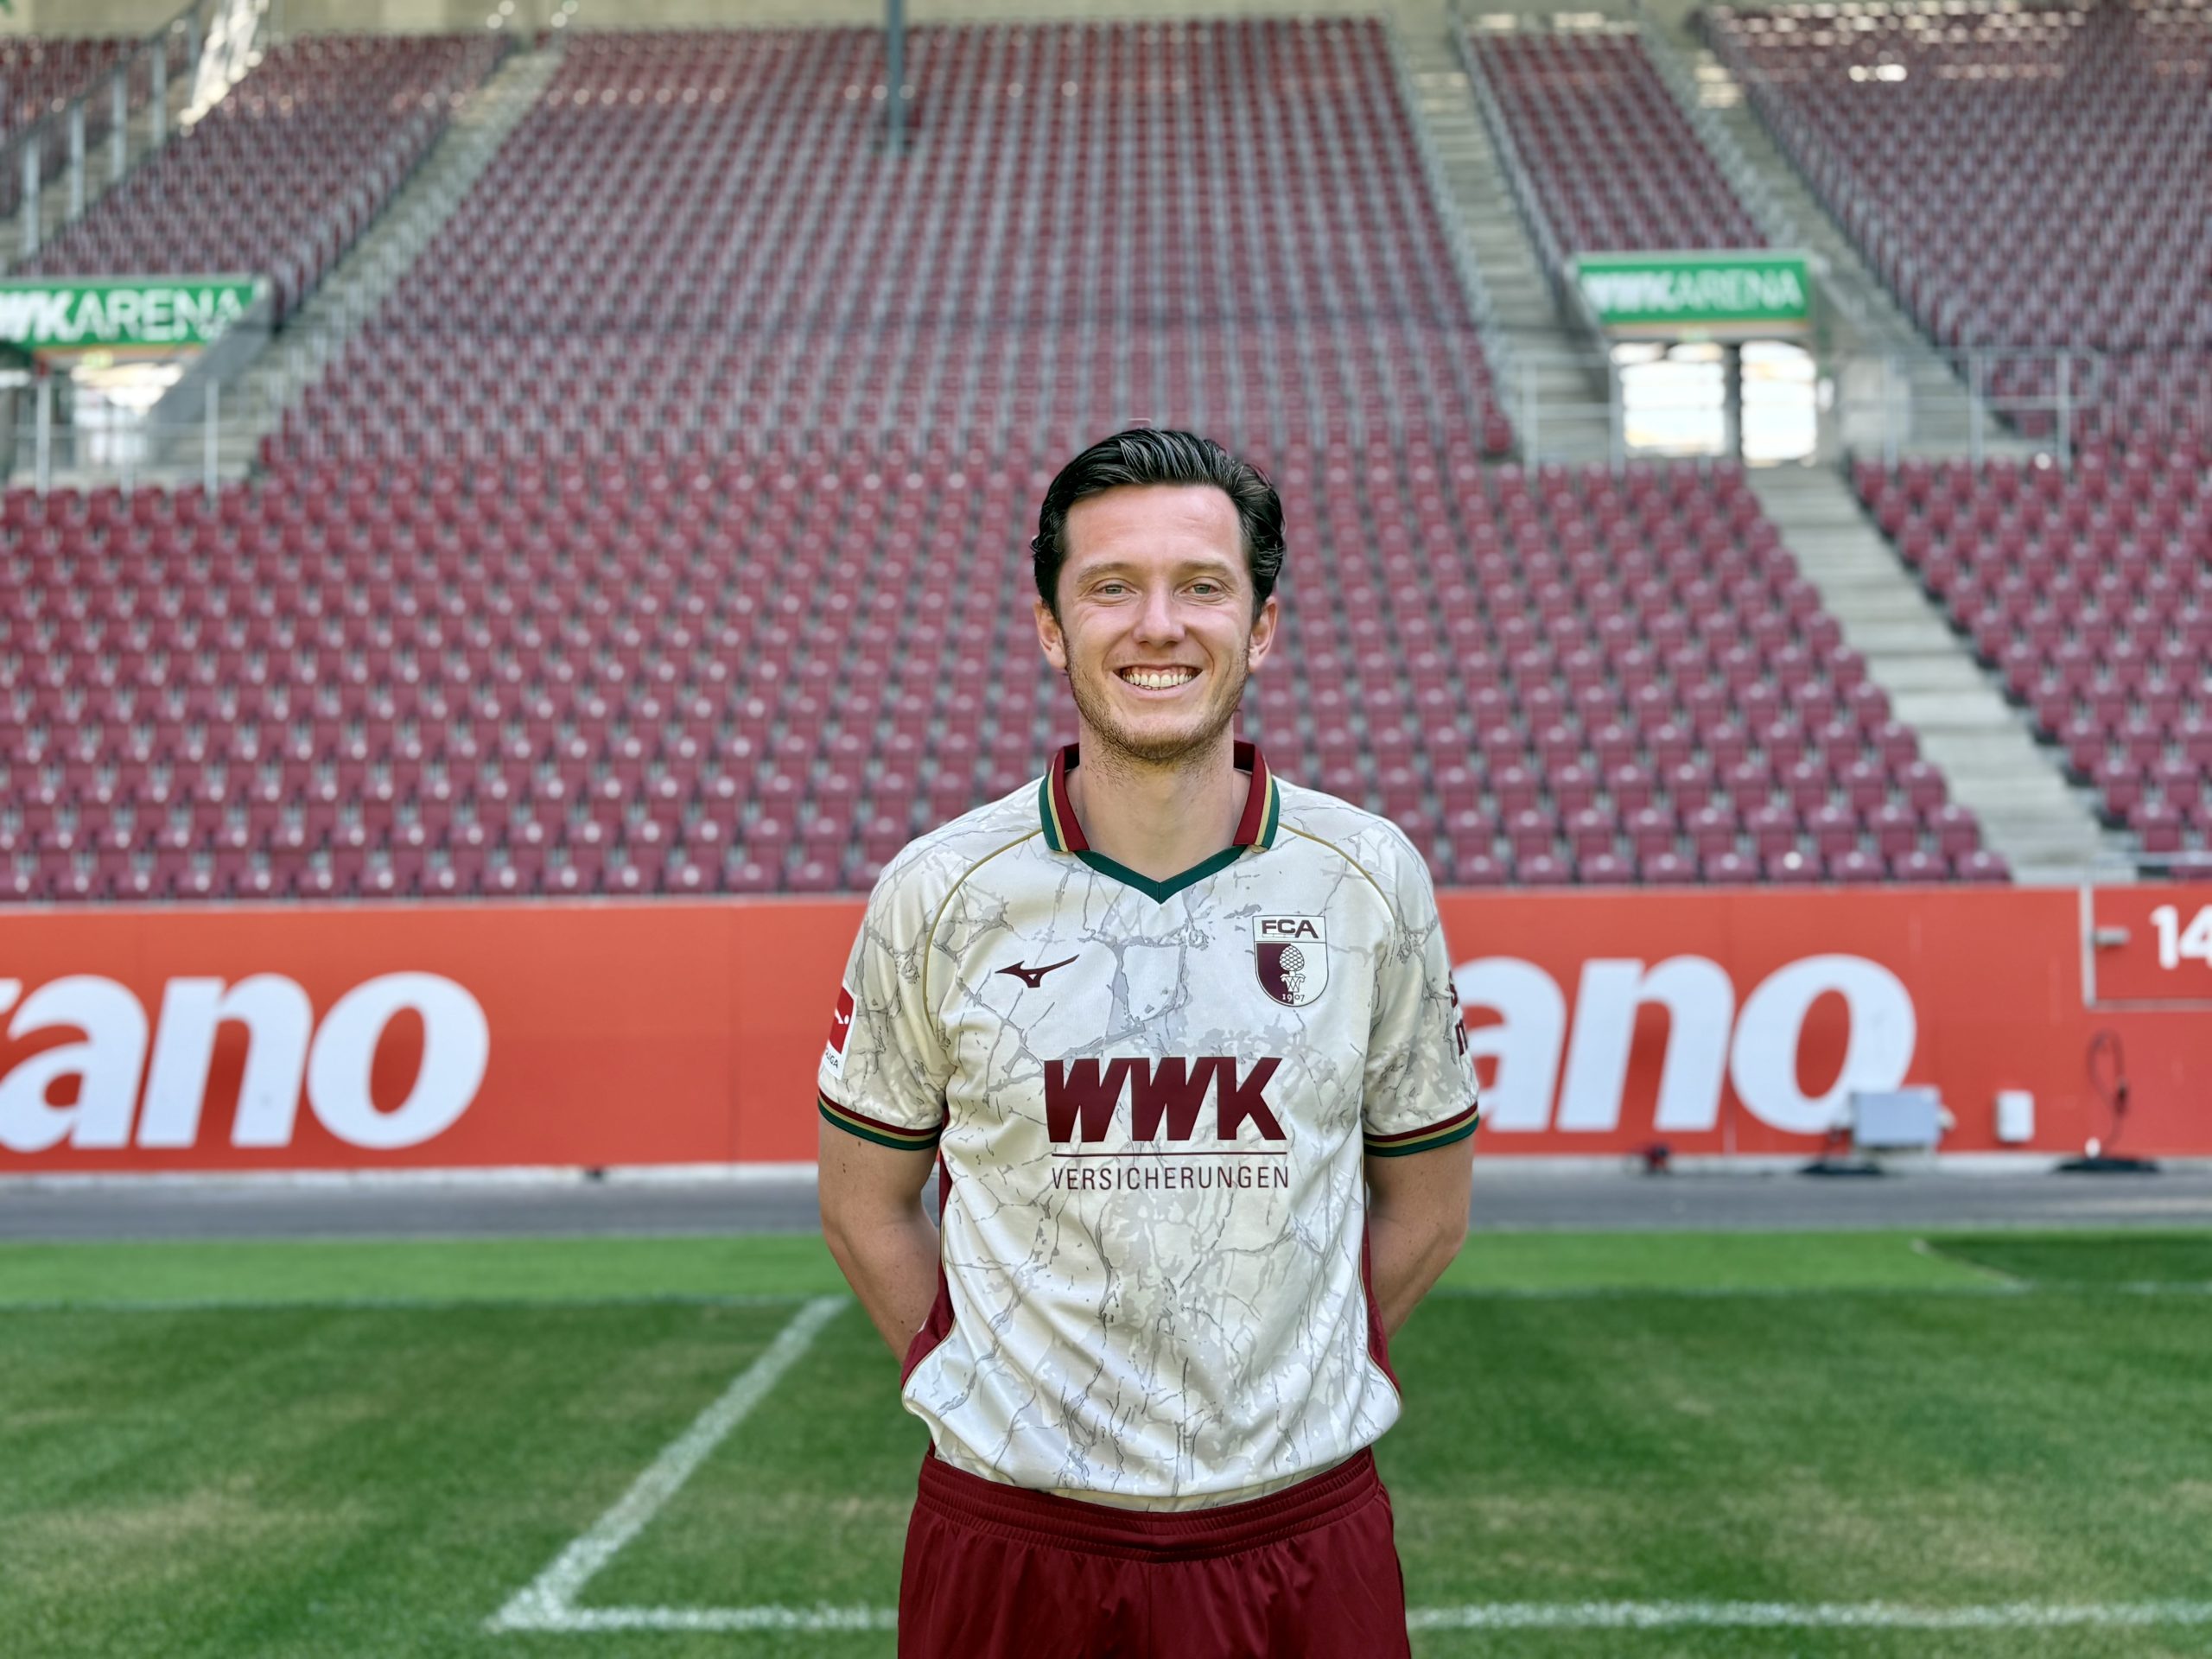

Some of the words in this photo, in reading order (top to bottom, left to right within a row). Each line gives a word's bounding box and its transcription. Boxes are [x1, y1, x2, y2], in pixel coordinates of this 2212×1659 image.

[1261, 918, 1319, 939] FCA
[1281, 993, 1306, 1002] 1907
[1044, 1056, 1287, 1143] WWK
[1051, 1166, 1289, 1190] VERSICHERUNGEN
